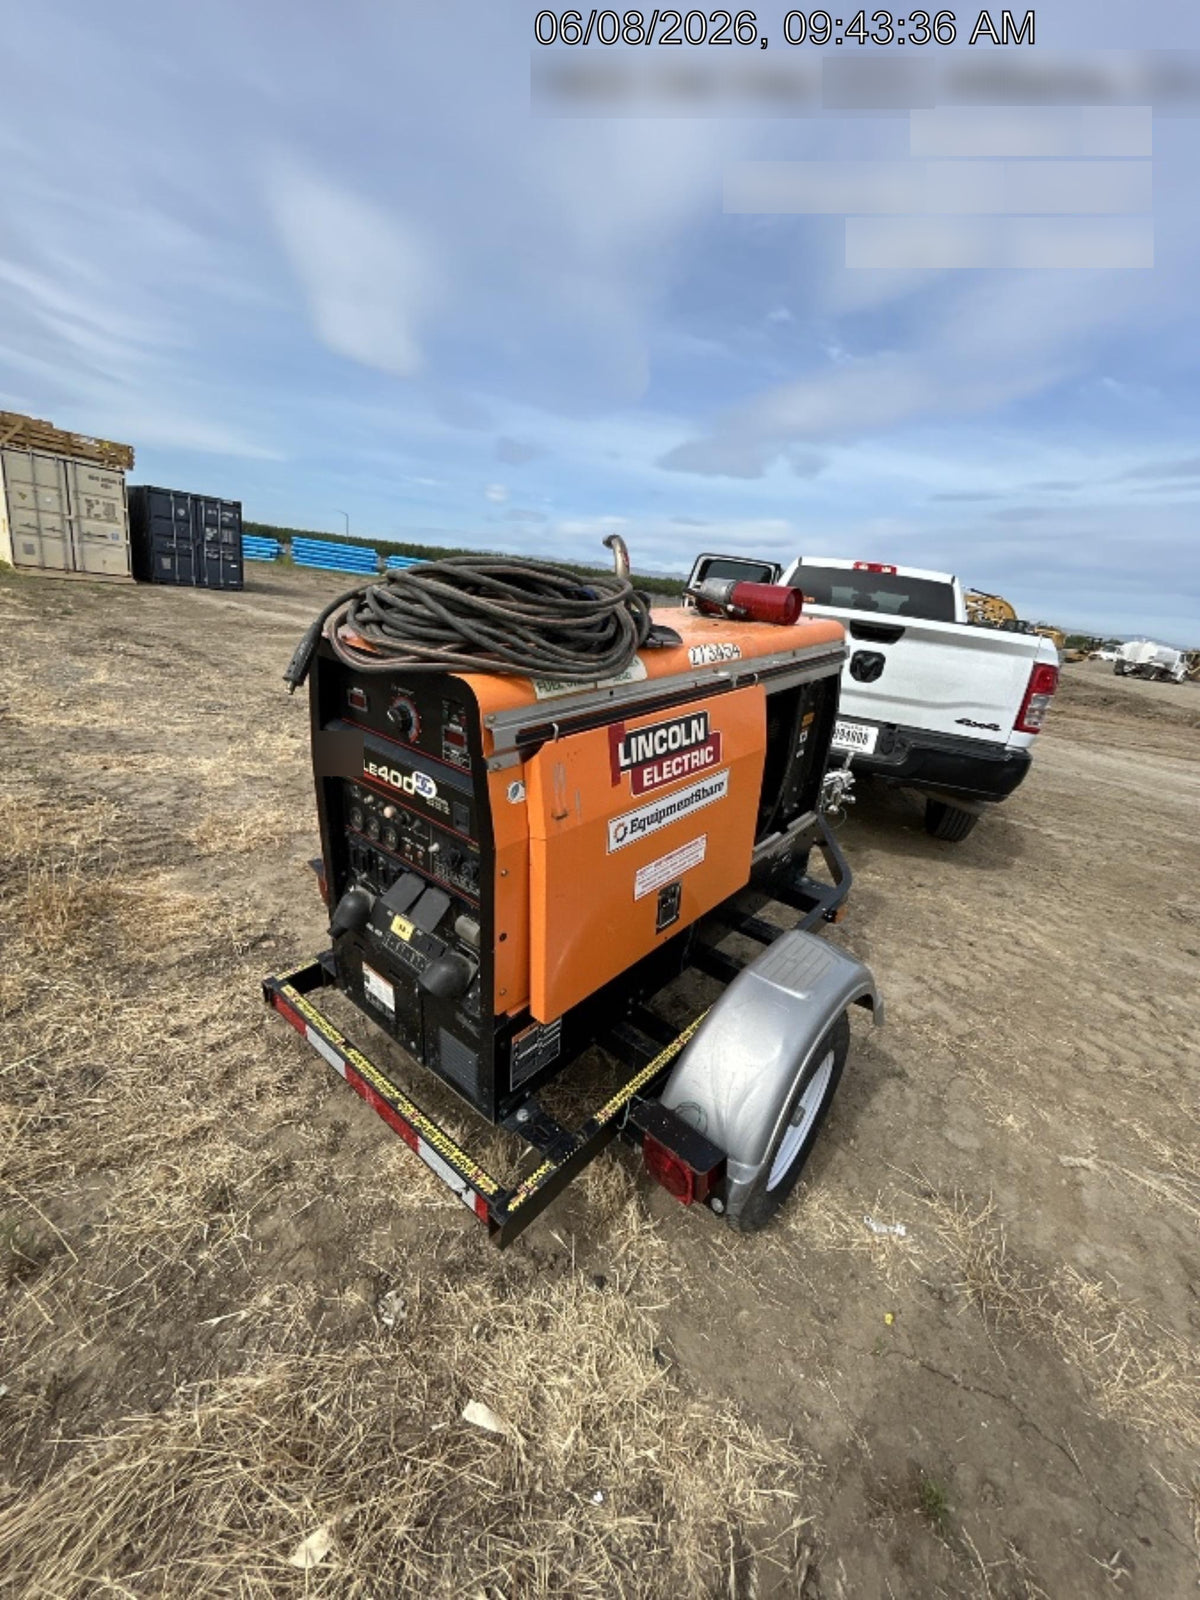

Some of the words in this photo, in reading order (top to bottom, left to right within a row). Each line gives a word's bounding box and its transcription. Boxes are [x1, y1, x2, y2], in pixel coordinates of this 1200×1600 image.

[618, 717, 706, 768] LINCOLN
[642, 745, 715, 788] ELECTRIC
[629, 781, 725, 835] EquipmentShare
